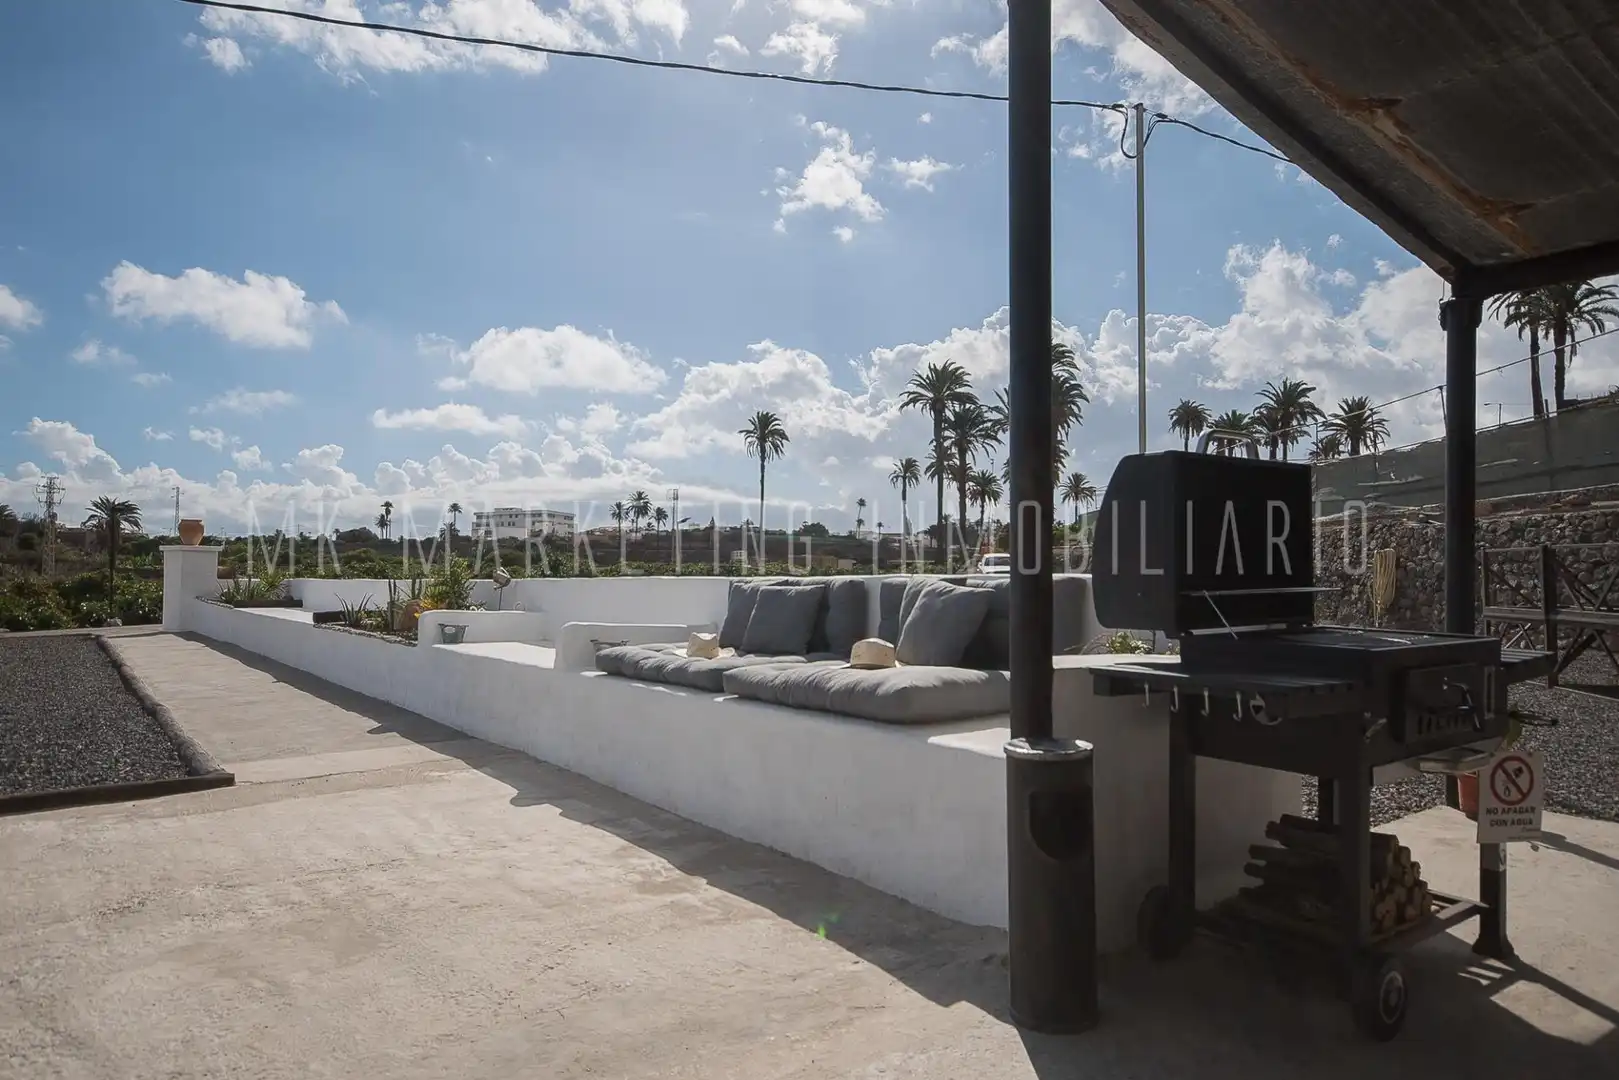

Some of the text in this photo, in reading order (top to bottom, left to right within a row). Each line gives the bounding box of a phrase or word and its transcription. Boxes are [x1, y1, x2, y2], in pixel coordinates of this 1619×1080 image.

[1486, 806, 1535, 815] NO APAGAR
[1490, 818, 1532, 827] CON AGUA
